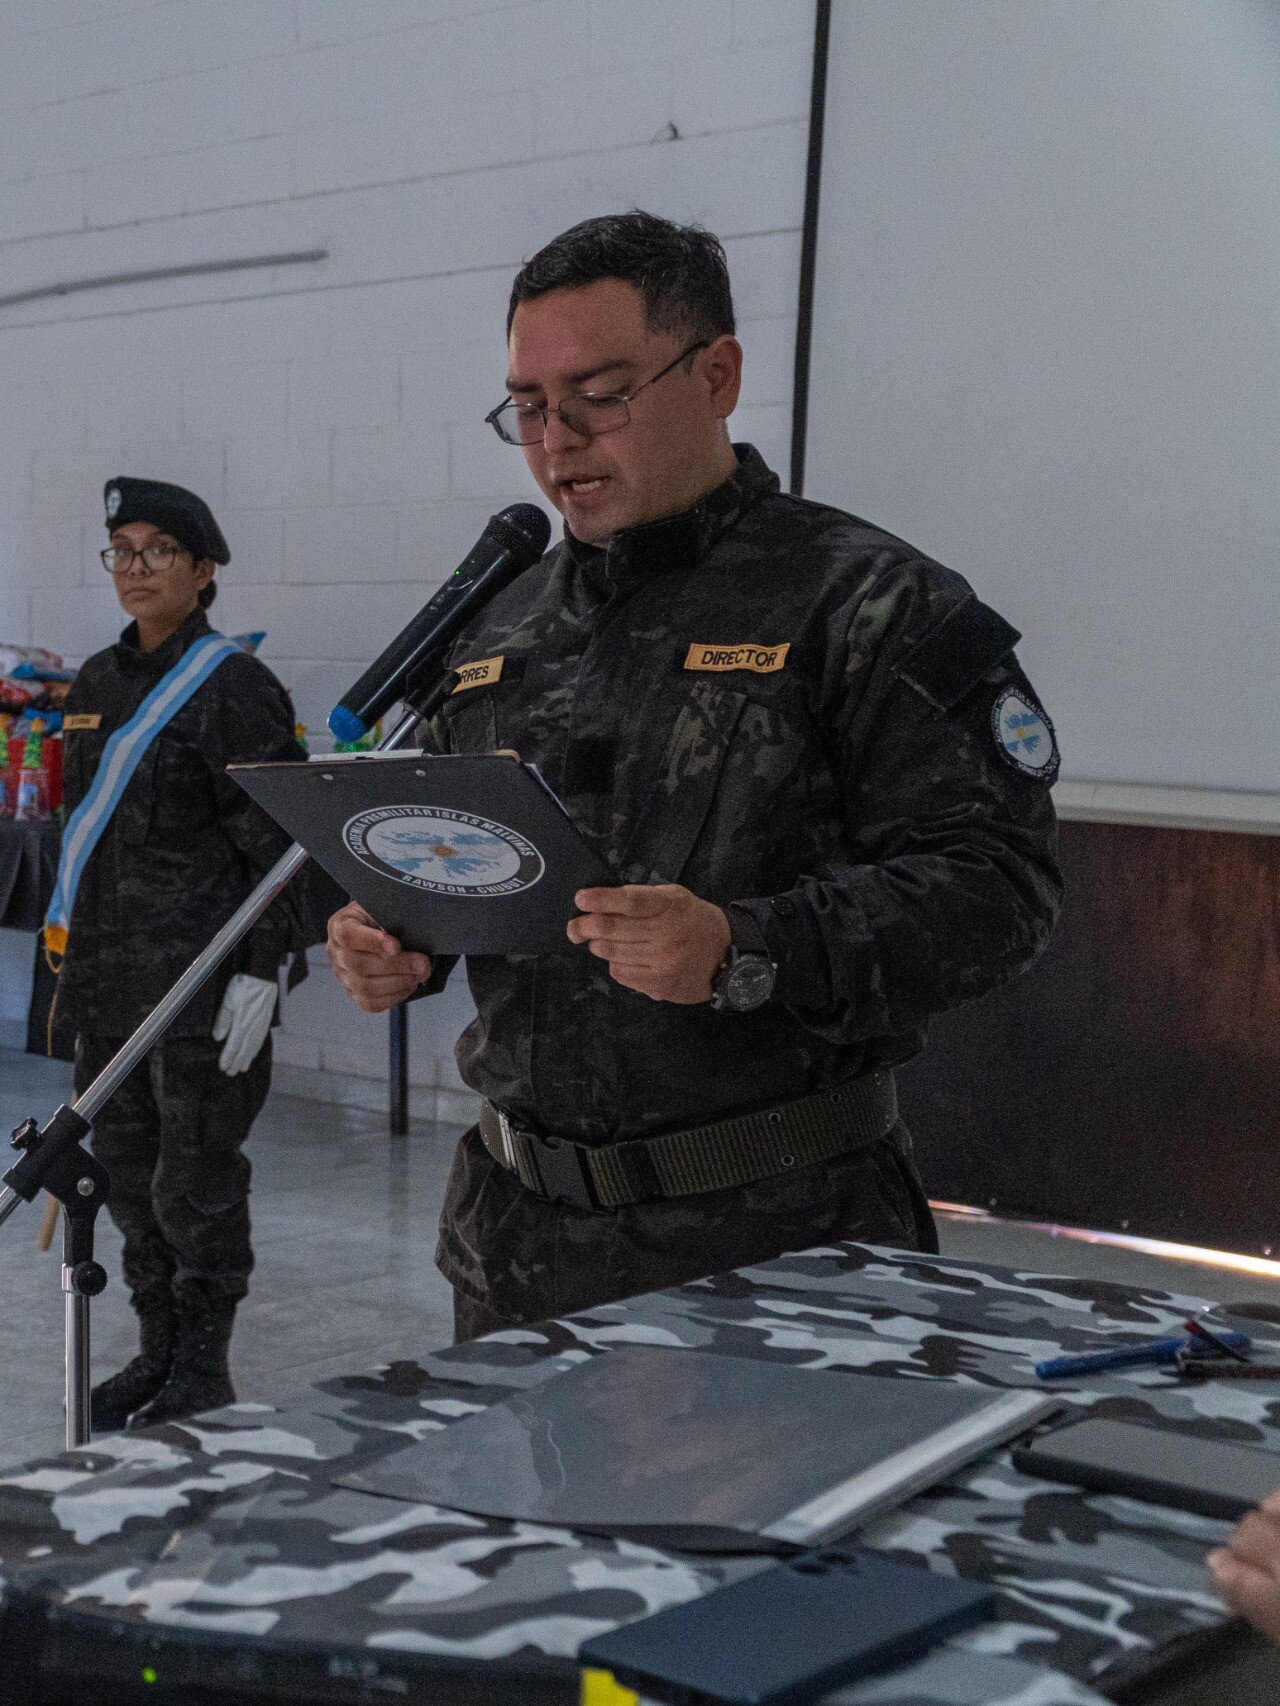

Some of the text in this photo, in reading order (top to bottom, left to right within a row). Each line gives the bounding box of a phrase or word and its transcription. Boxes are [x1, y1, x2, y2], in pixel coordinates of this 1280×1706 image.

[701, 648, 778, 667] DIRECTOR
[459, 665, 489, 684] RRES
[349, 808, 535, 857] ACADEMIA PREMILITAR ISLAS MALVINAS
[401, 874, 467, 894] RAWSON
[476, 876, 526, 894] CHUBUT
